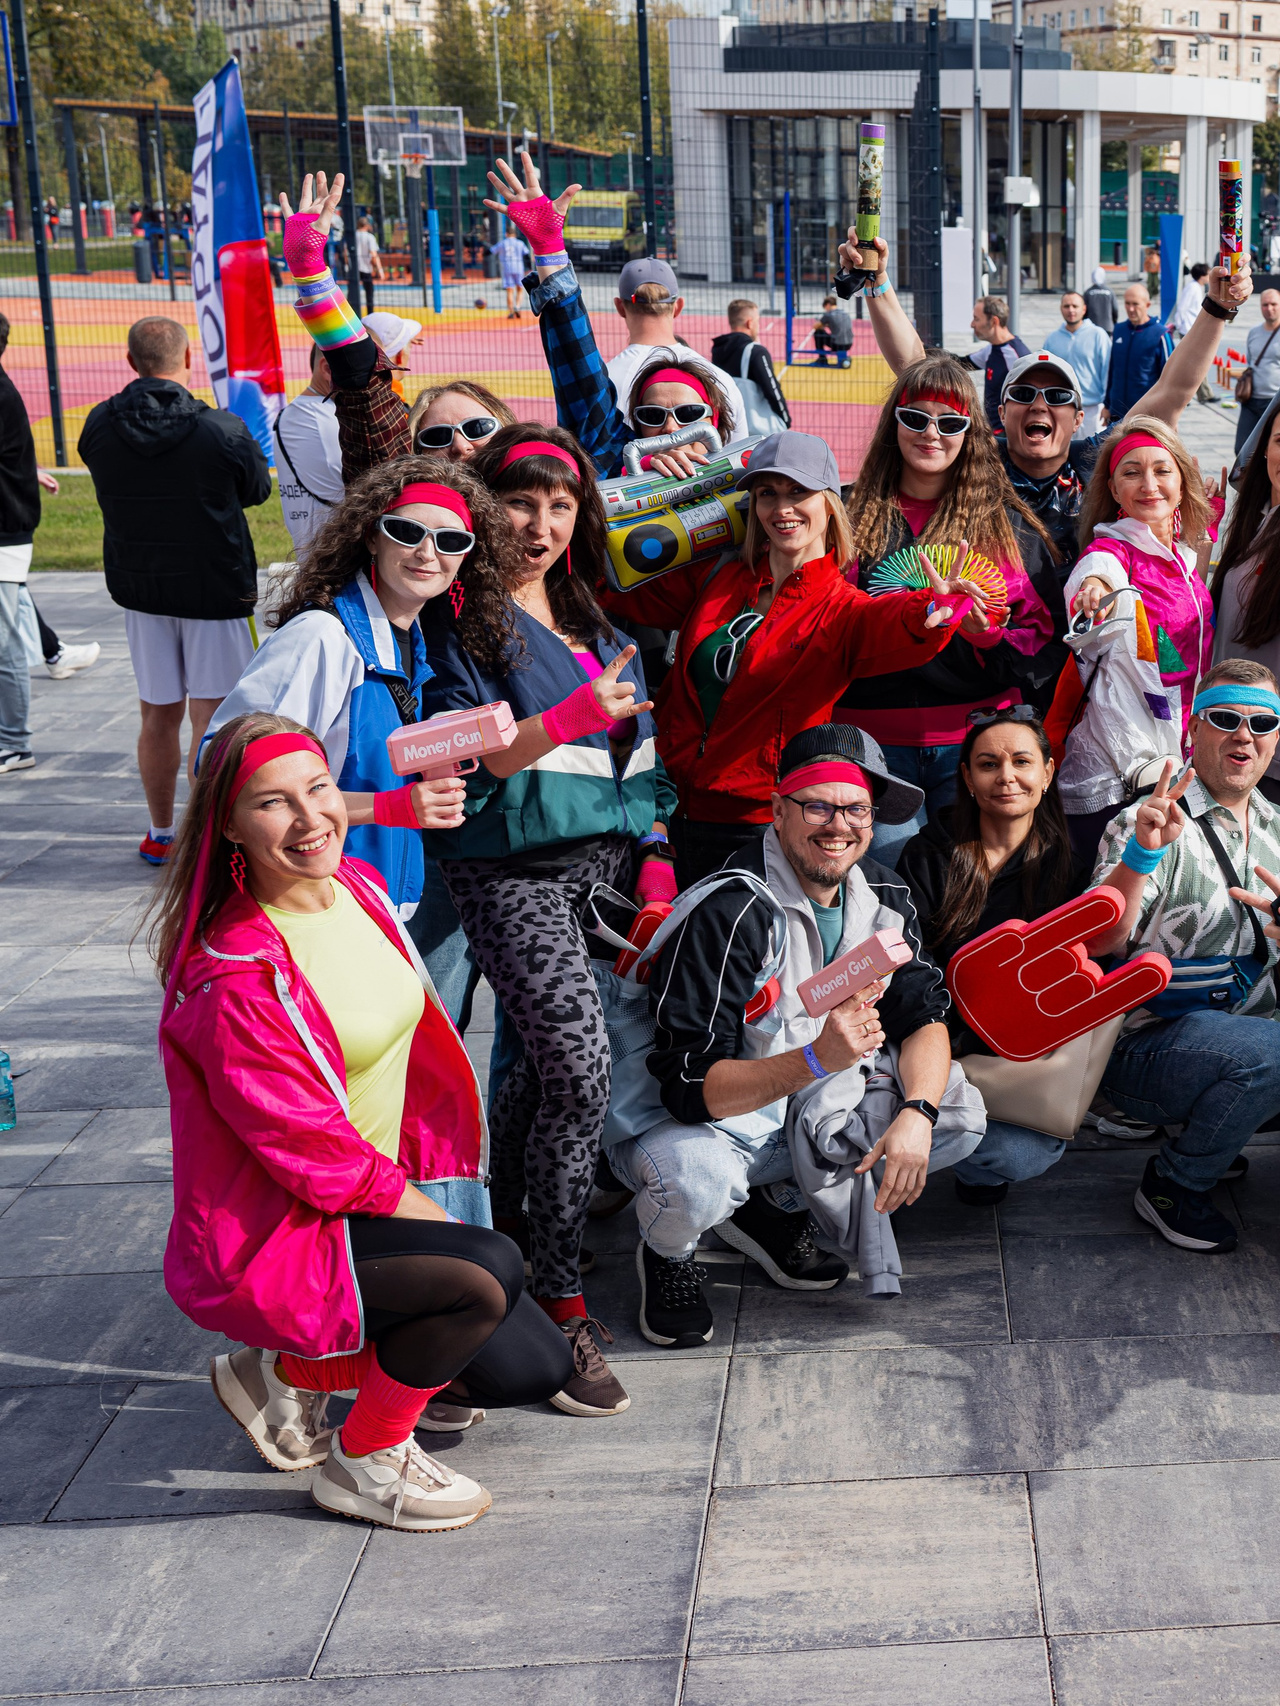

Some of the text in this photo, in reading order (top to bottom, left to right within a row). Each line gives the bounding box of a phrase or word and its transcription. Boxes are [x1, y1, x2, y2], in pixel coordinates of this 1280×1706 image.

[403, 731, 483, 762] Money Gun
[809, 955, 873, 1003] Money Gun
